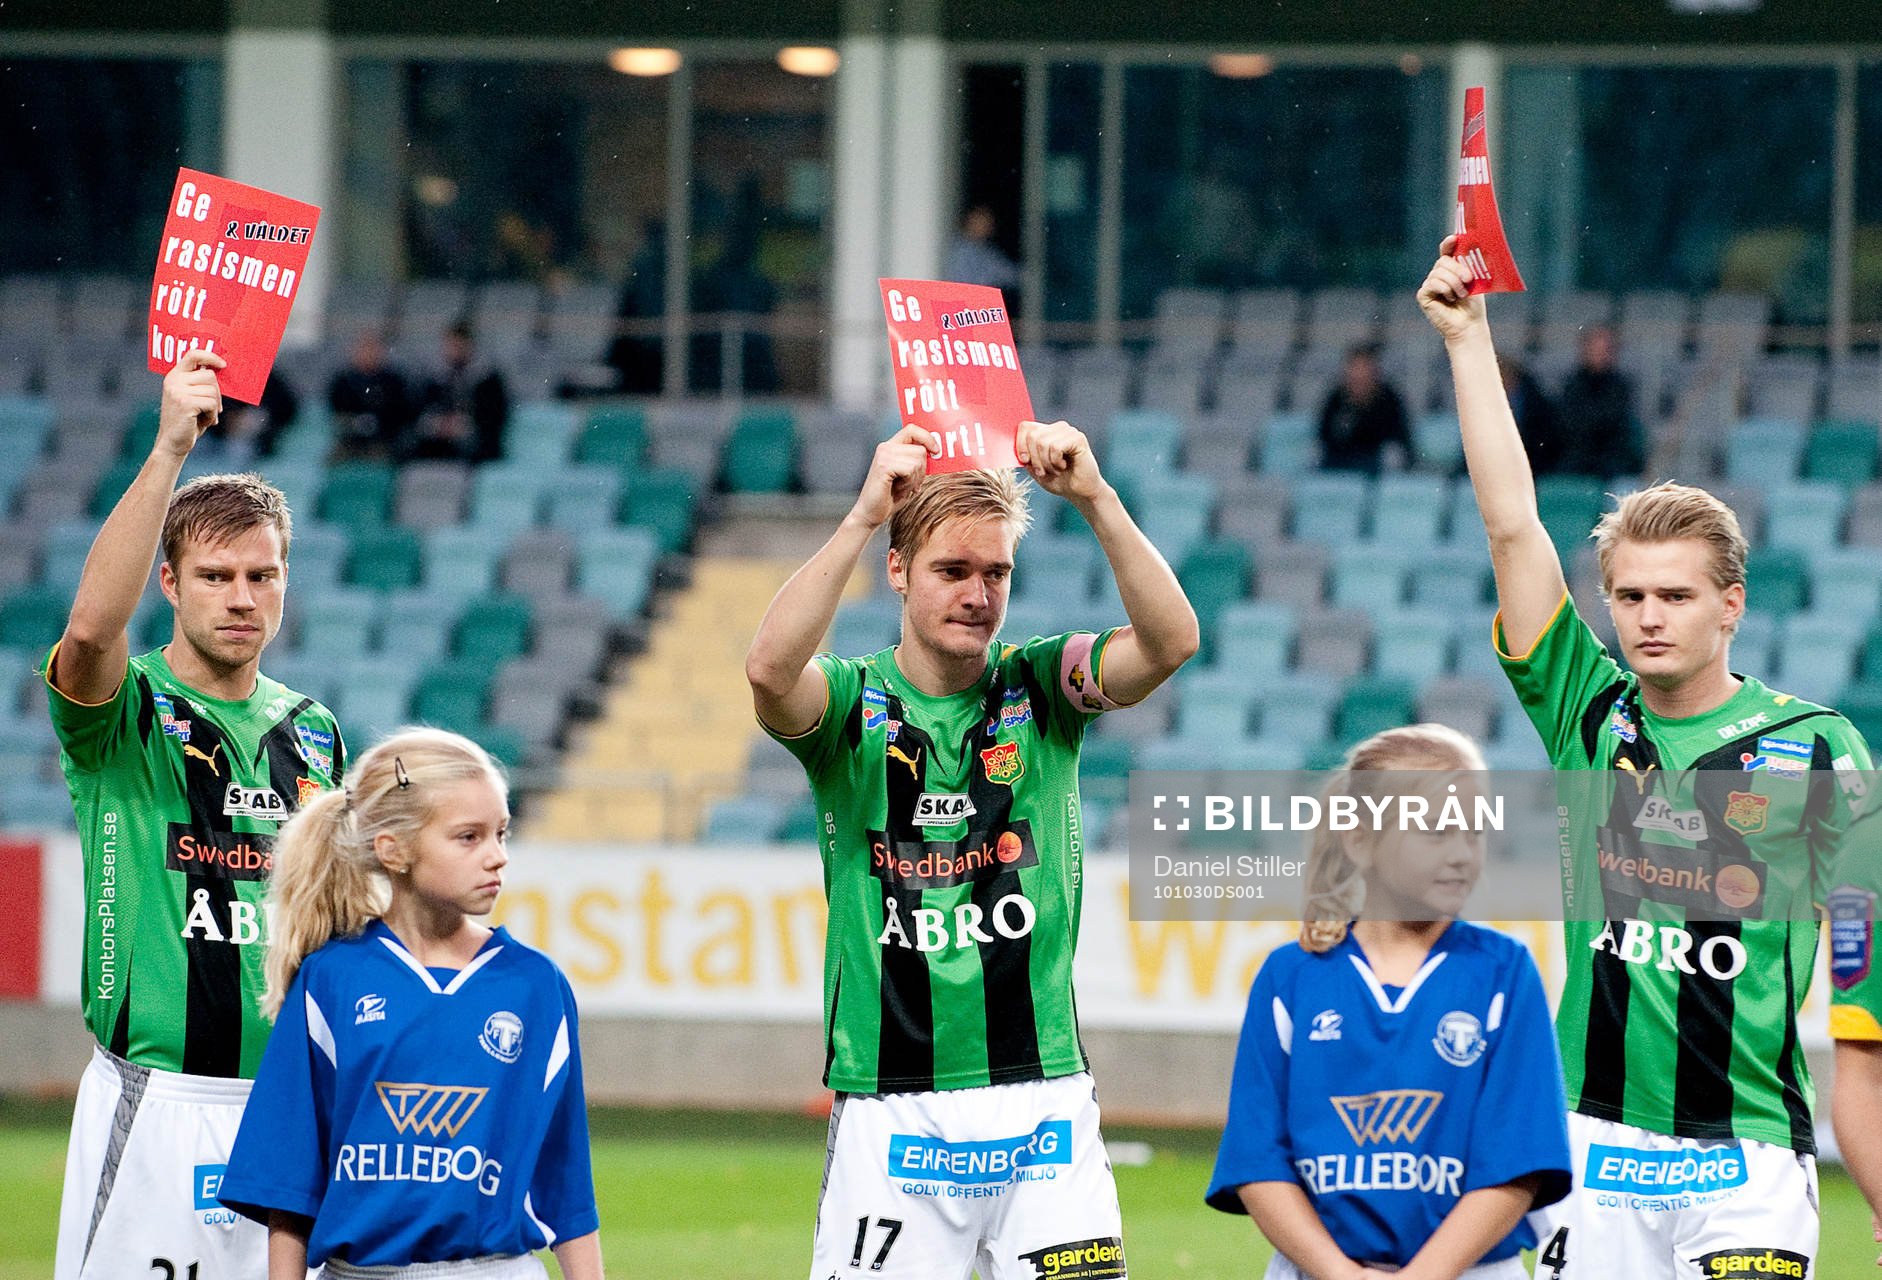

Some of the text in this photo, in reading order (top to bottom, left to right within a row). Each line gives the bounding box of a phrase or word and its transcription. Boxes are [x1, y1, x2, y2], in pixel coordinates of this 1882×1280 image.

[176, 182, 211, 221] Ge
[226, 220, 311, 244] & VÅLDET
[164, 236, 296, 298] rasismen
[155, 280, 207, 321] rött
[888, 289, 922, 323] Ge
[941, 308, 1006, 331] & VÅLDET
[897, 334, 1017, 371] rasismen
[904, 378, 960, 415] rött
[929, 422, 985, 460] ort!
[229, 788, 282, 810] SAB
[920, 798, 968, 815] SKA
[177, 835, 273, 870] Swedba
[98, 811, 117, 1000] KontorsPlatsen.se
[181, 888, 272, 945] ÅB
[878, 894, 1036, 952] ÅBRO
[335, 1143, 503, 1196] RELLEBOG
[902, 1182, 940, 1197] GOLV
[1015, 1165, 1057, 1184] MILJÖ
[850, 1215, 903, 1269] 17
[1043, 1241, 1123, 1275] gardera
[1541, 1226, 1570, 1280] 4
[1711, 1251, 1803, 1278] gardera
